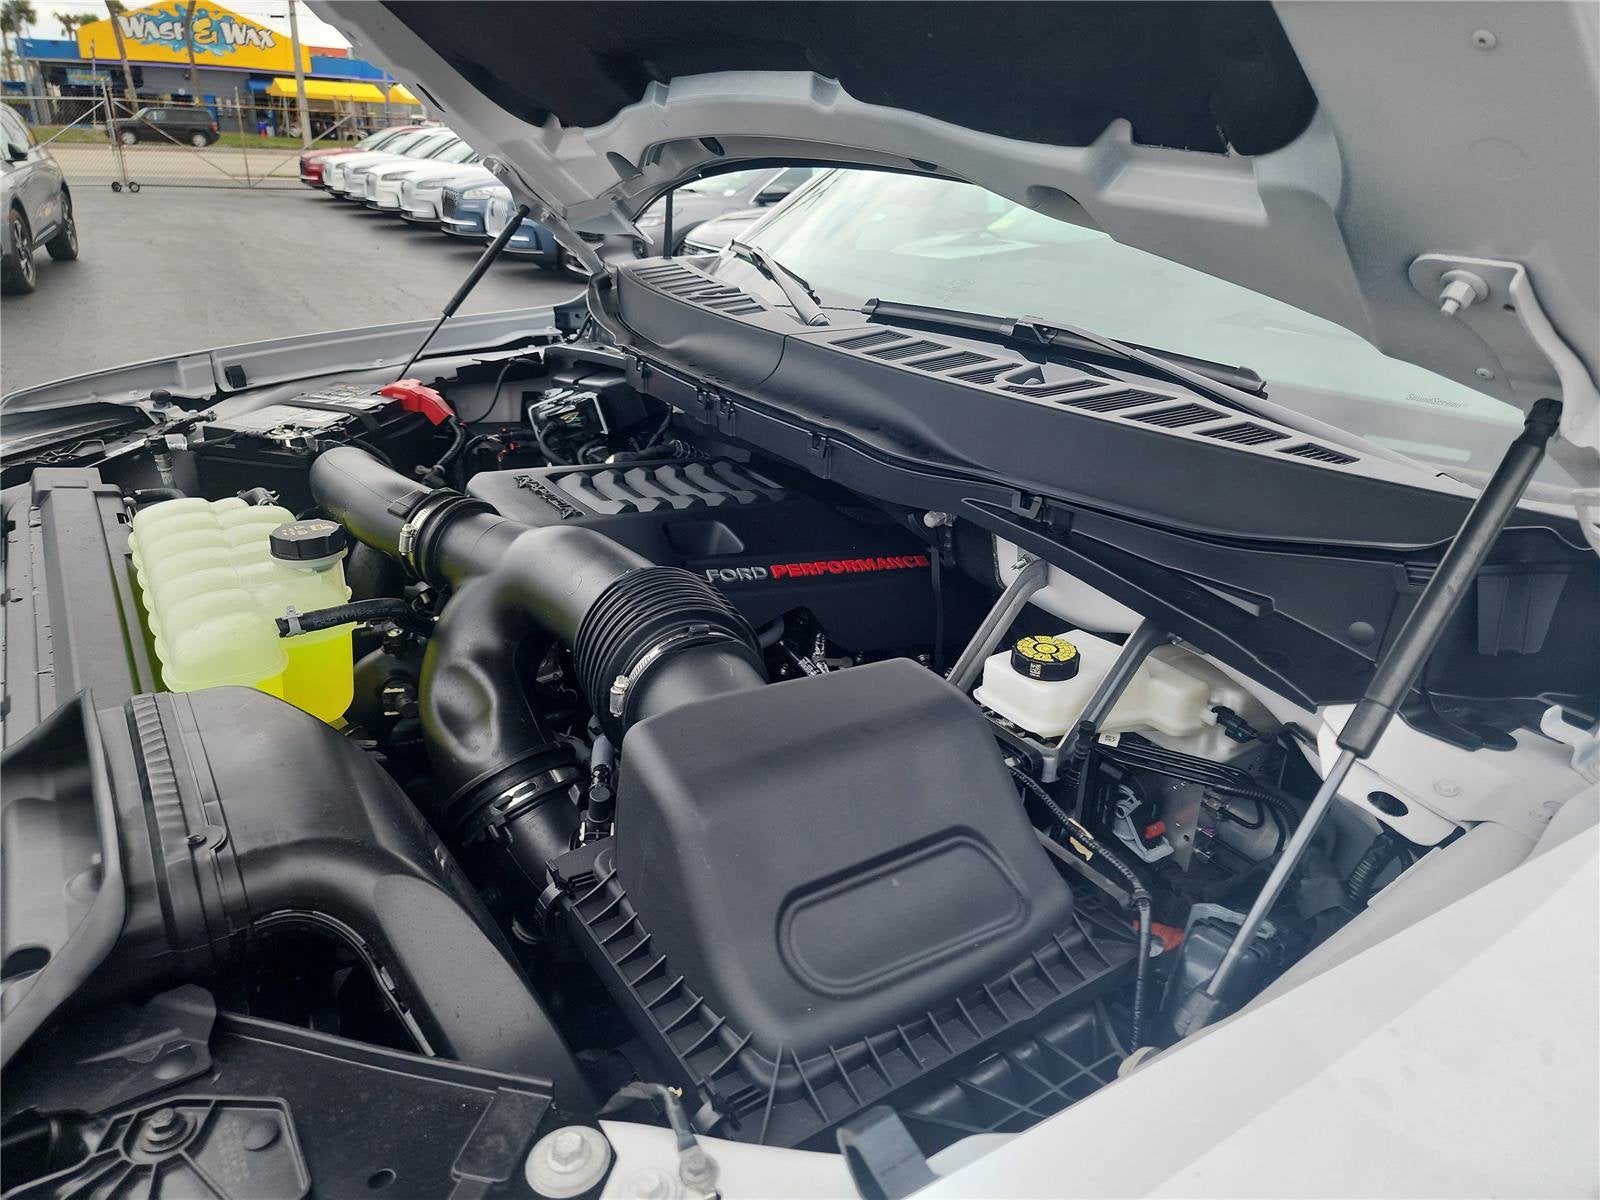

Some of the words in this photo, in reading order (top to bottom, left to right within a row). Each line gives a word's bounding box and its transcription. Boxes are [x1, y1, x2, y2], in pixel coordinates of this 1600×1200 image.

[192, 18, 218, 44] &
[220, 22, 276, 49] WAX
[705, 566, 769, 584] FORD
[770, 555, 929, 580] PERFORMANCE
